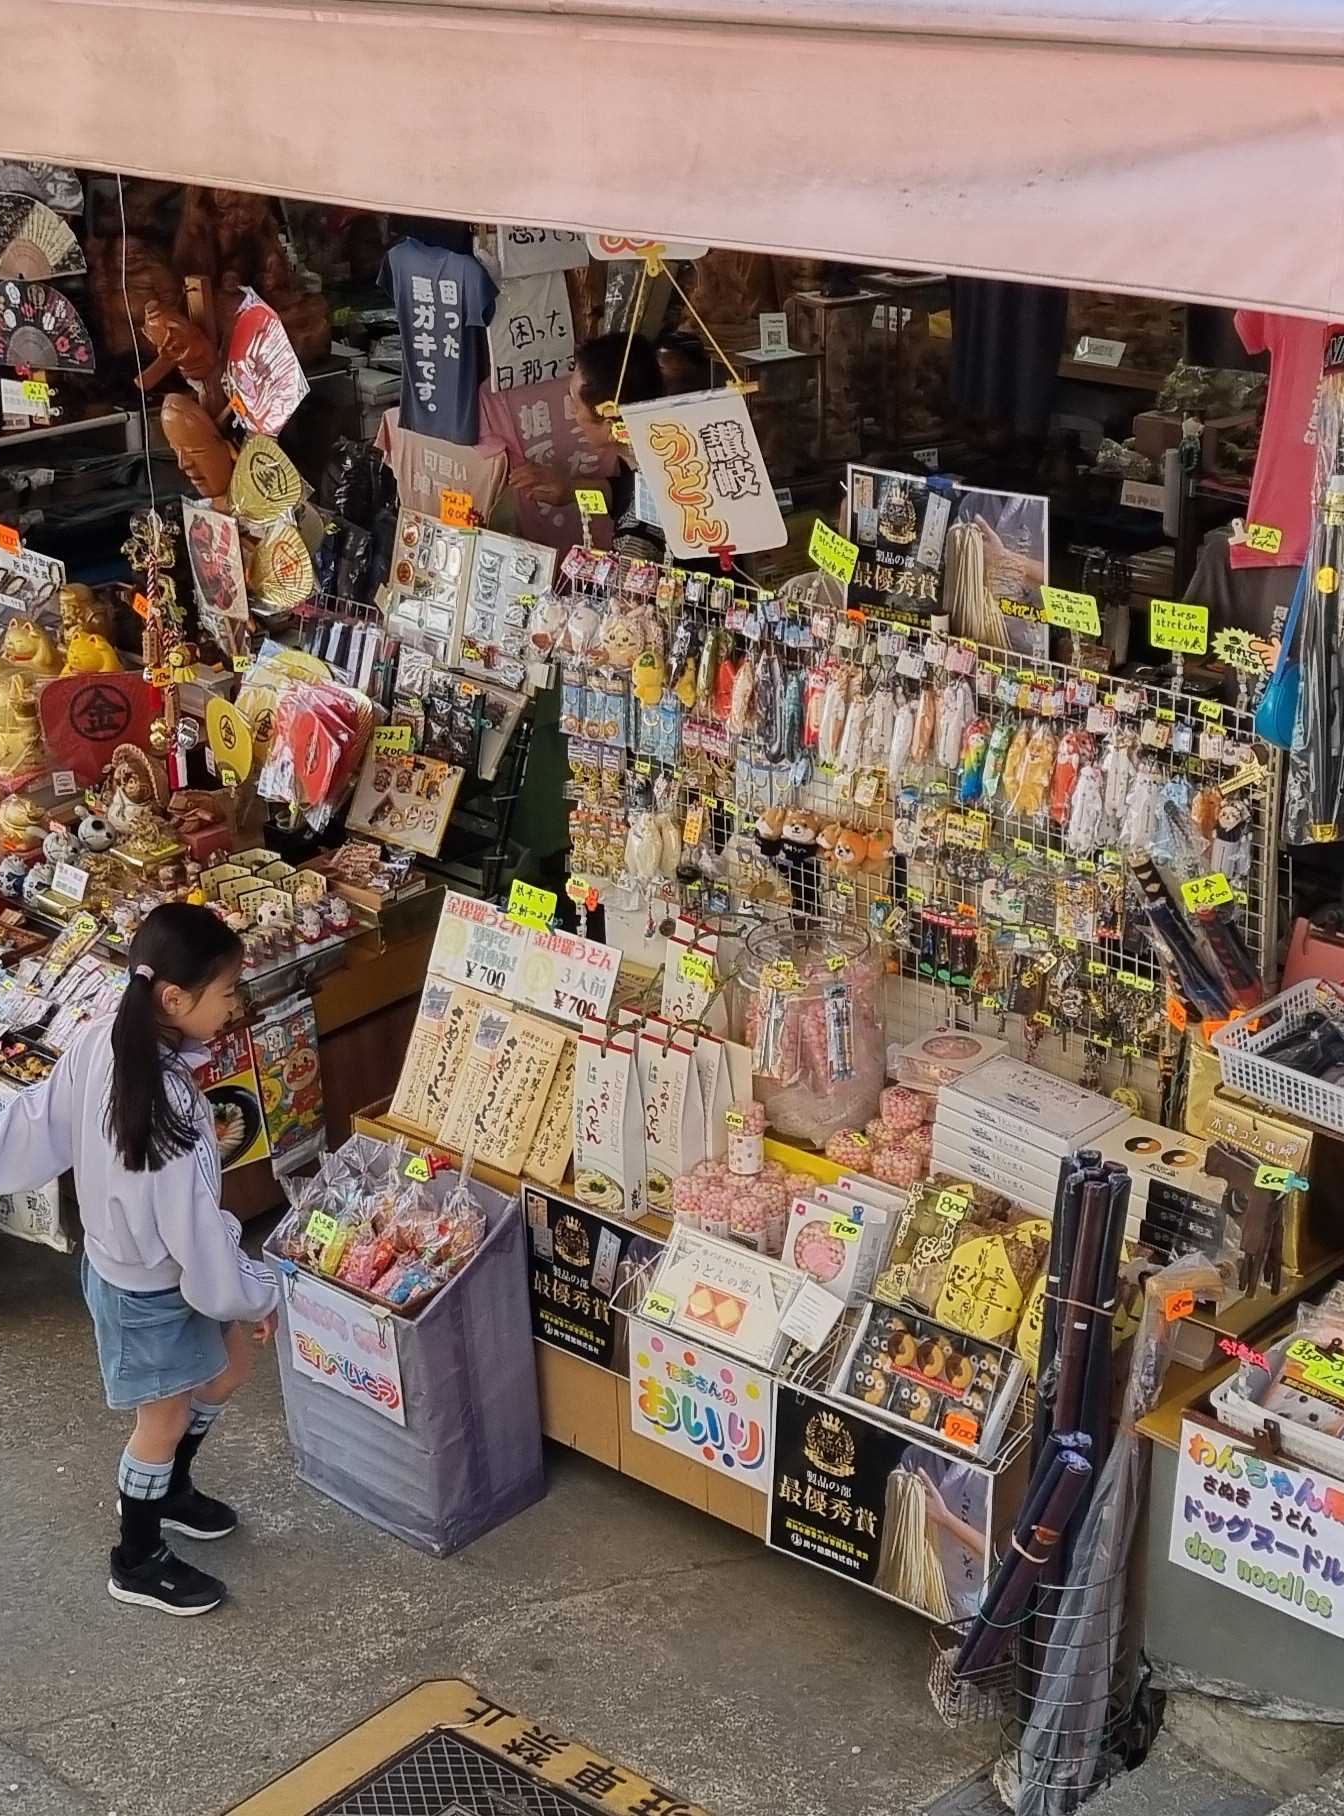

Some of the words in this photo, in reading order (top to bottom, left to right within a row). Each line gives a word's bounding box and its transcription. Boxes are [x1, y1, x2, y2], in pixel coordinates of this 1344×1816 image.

[439, 279, 462, 360] 困った
[509, 310, 567, 349] 困った
[411, 275, 438, 413] 悪ガキです。
[699, 421, 760, 499] 讃岐
[650, 422, 729, 548] うどん
[855, 561, 940, 602] 最優秀賞
[1153, 603, 1169, 616] The
[80, 686, 126, 732] 金
[465, 958, 507, 990] ¥700
[560, 966, 609, 1000] 3人前
[940, 1197, 966, 1213] 800
[835, 1221, 858, 1235] 700
[647, 1299, 670, 1314] 900
[638, 1374, 766, 1471] おいり
[951, 1421, 975, 1441] 900
[806, 1469, 853, 1500] 製品の部
[778, 1473, 879, 1539] 最優秀賞
[1203, 1474, 1252, 1509] さぬき
[1270, 1500, 1318, 1538] うどん
[1184, 1531, 1227, 1574] dog
[1237, 1558, 1333, 1619] noodles
